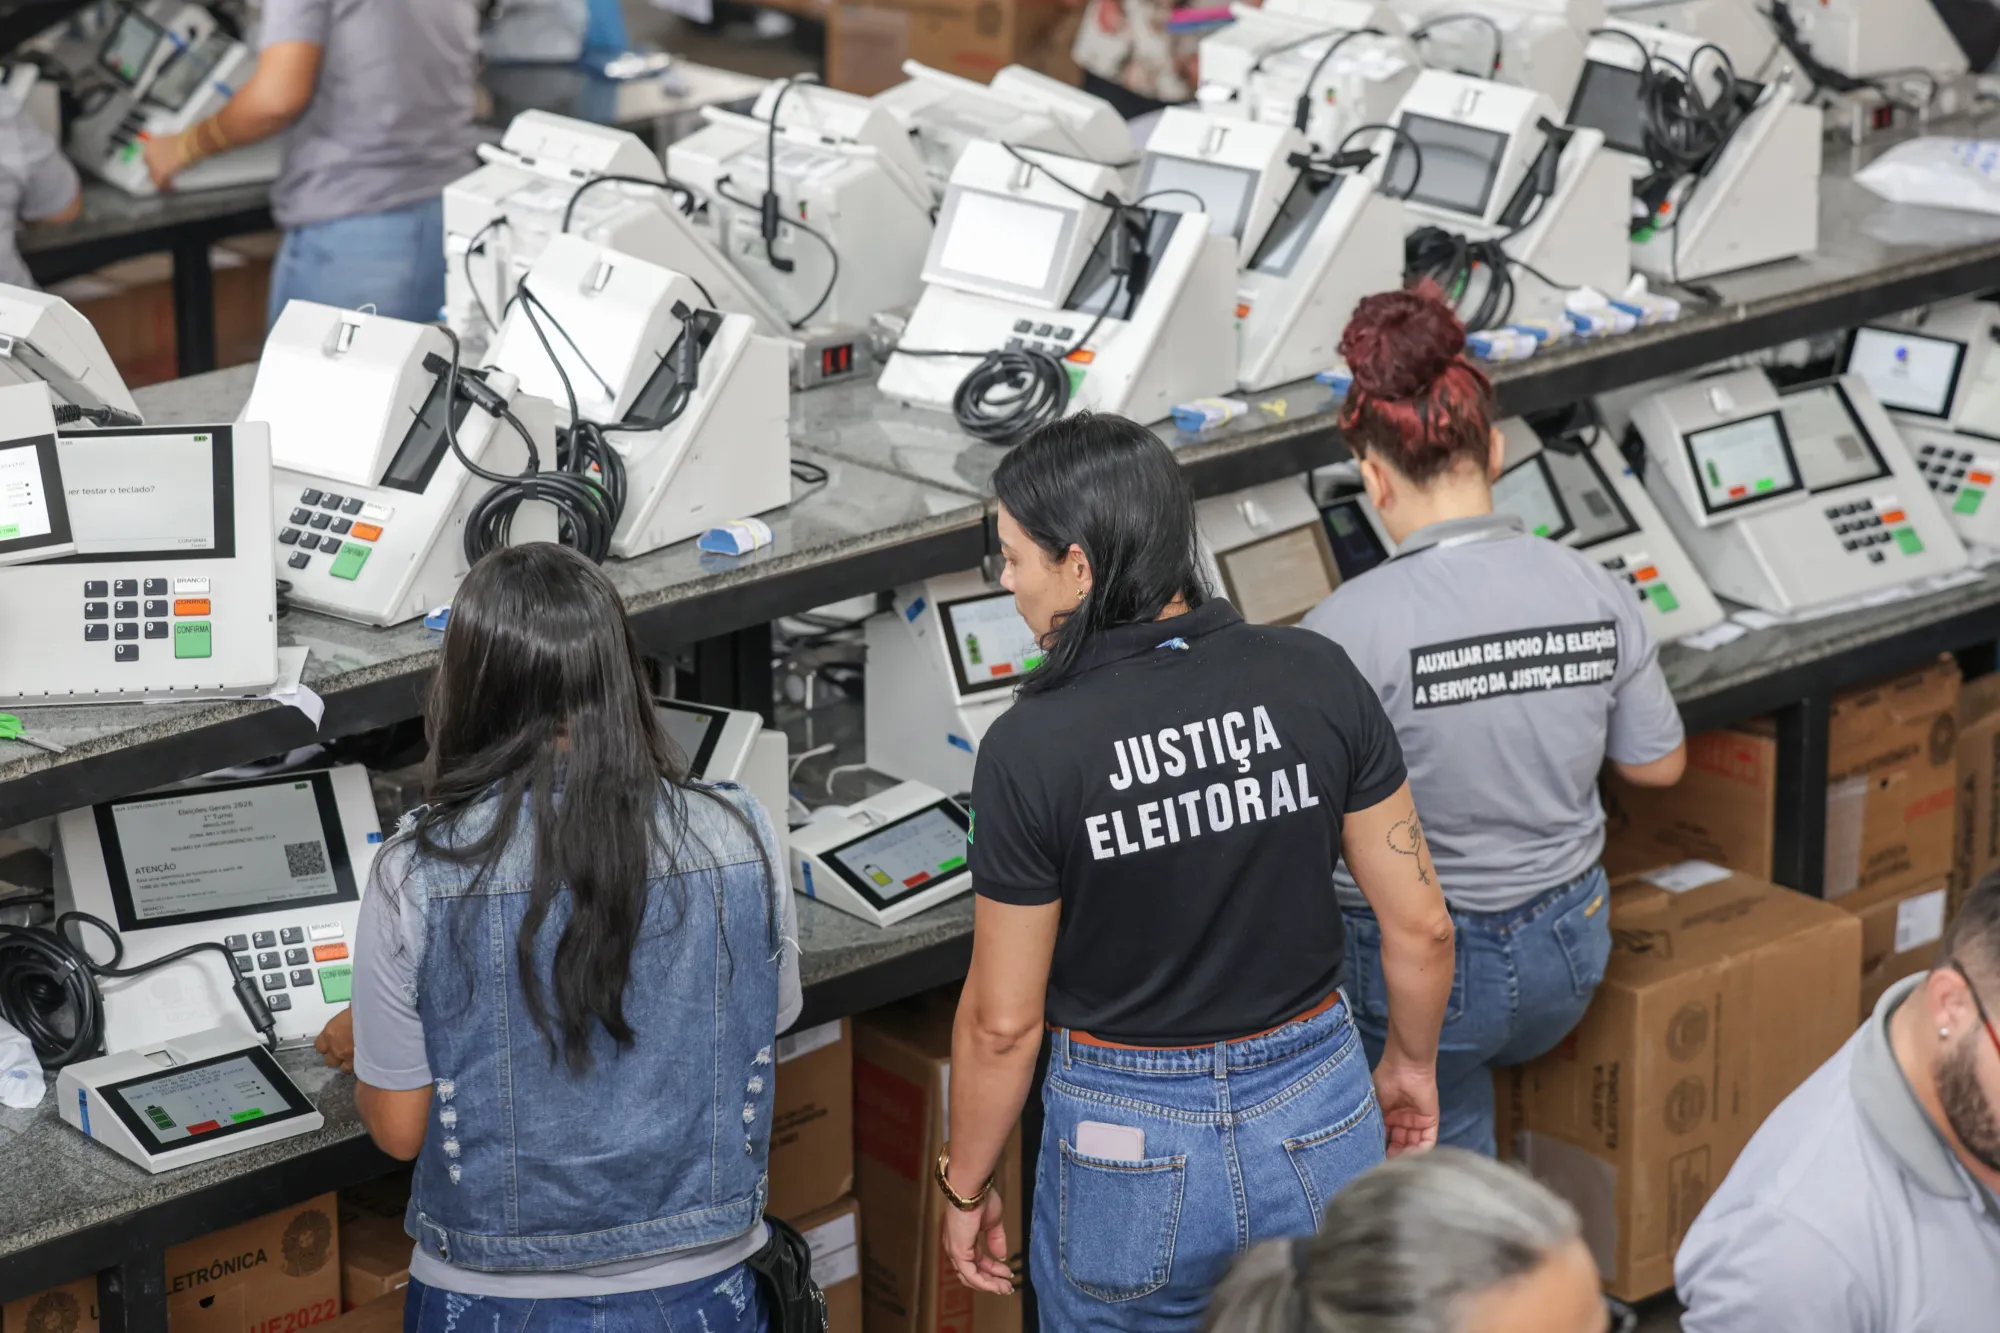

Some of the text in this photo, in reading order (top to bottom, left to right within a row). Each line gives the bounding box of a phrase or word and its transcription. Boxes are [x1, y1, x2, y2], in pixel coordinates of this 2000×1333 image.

[82, 486, 107, 495] testar
[118, 485, 156, 494] teclado?
[323, 493, 331, 502] 2
[344, 497, 352, 506] 3
[313, 512, 320, 521] 5
[333, 517, 341, 526] 6
[302, 532, 309, 541] 8
[322, 537, 330, 546] 9
[291, 551, 298, 560] 0
[87, 581, 94, 591] 1
[116, 580, 123, 590] 2
[146, 579, 153, 588] 3
[86, 602, 94, 612] 4
[116, 601, 124, 611] 5
[146, 600, 154, 610] 6
[87, 622, 209, 635] 7 8 9 CONFIRMA
[117, 645, 124, 654] 0
[1416, 644, 1482, 675] AUXILIAR
[1484, 642, 1503, 663] DE
[1545, 632, 1565, 655] ÀS
[1415, 685, 1428, 704] A
[1429, 675, 1488, 701] SERVIÇO
[1489, 671, 1508, 693] DA
[1109, 704, 1282, 791] JUSTIÇA
[178, 805, 208, 817] Eleições
[209, 803, 232, 812] Gerais
[212, 811, 234, 820] Turno
[1085, 763, 1320, 861] ELEITORAL
[134, 862, 177, 876] ATENÇÃO
[228, 922, 340, 945] 1 2 3 BRANCO
[260, 953, 268, 962] 5
[287, 949, 295, 958] 6
[264, 974, 272, 983] 8
[292, 970, 300, 979] 9
[270, 995, 278, 1004] 0
[165, 1248, 268, 1297] ETRÔNICA
